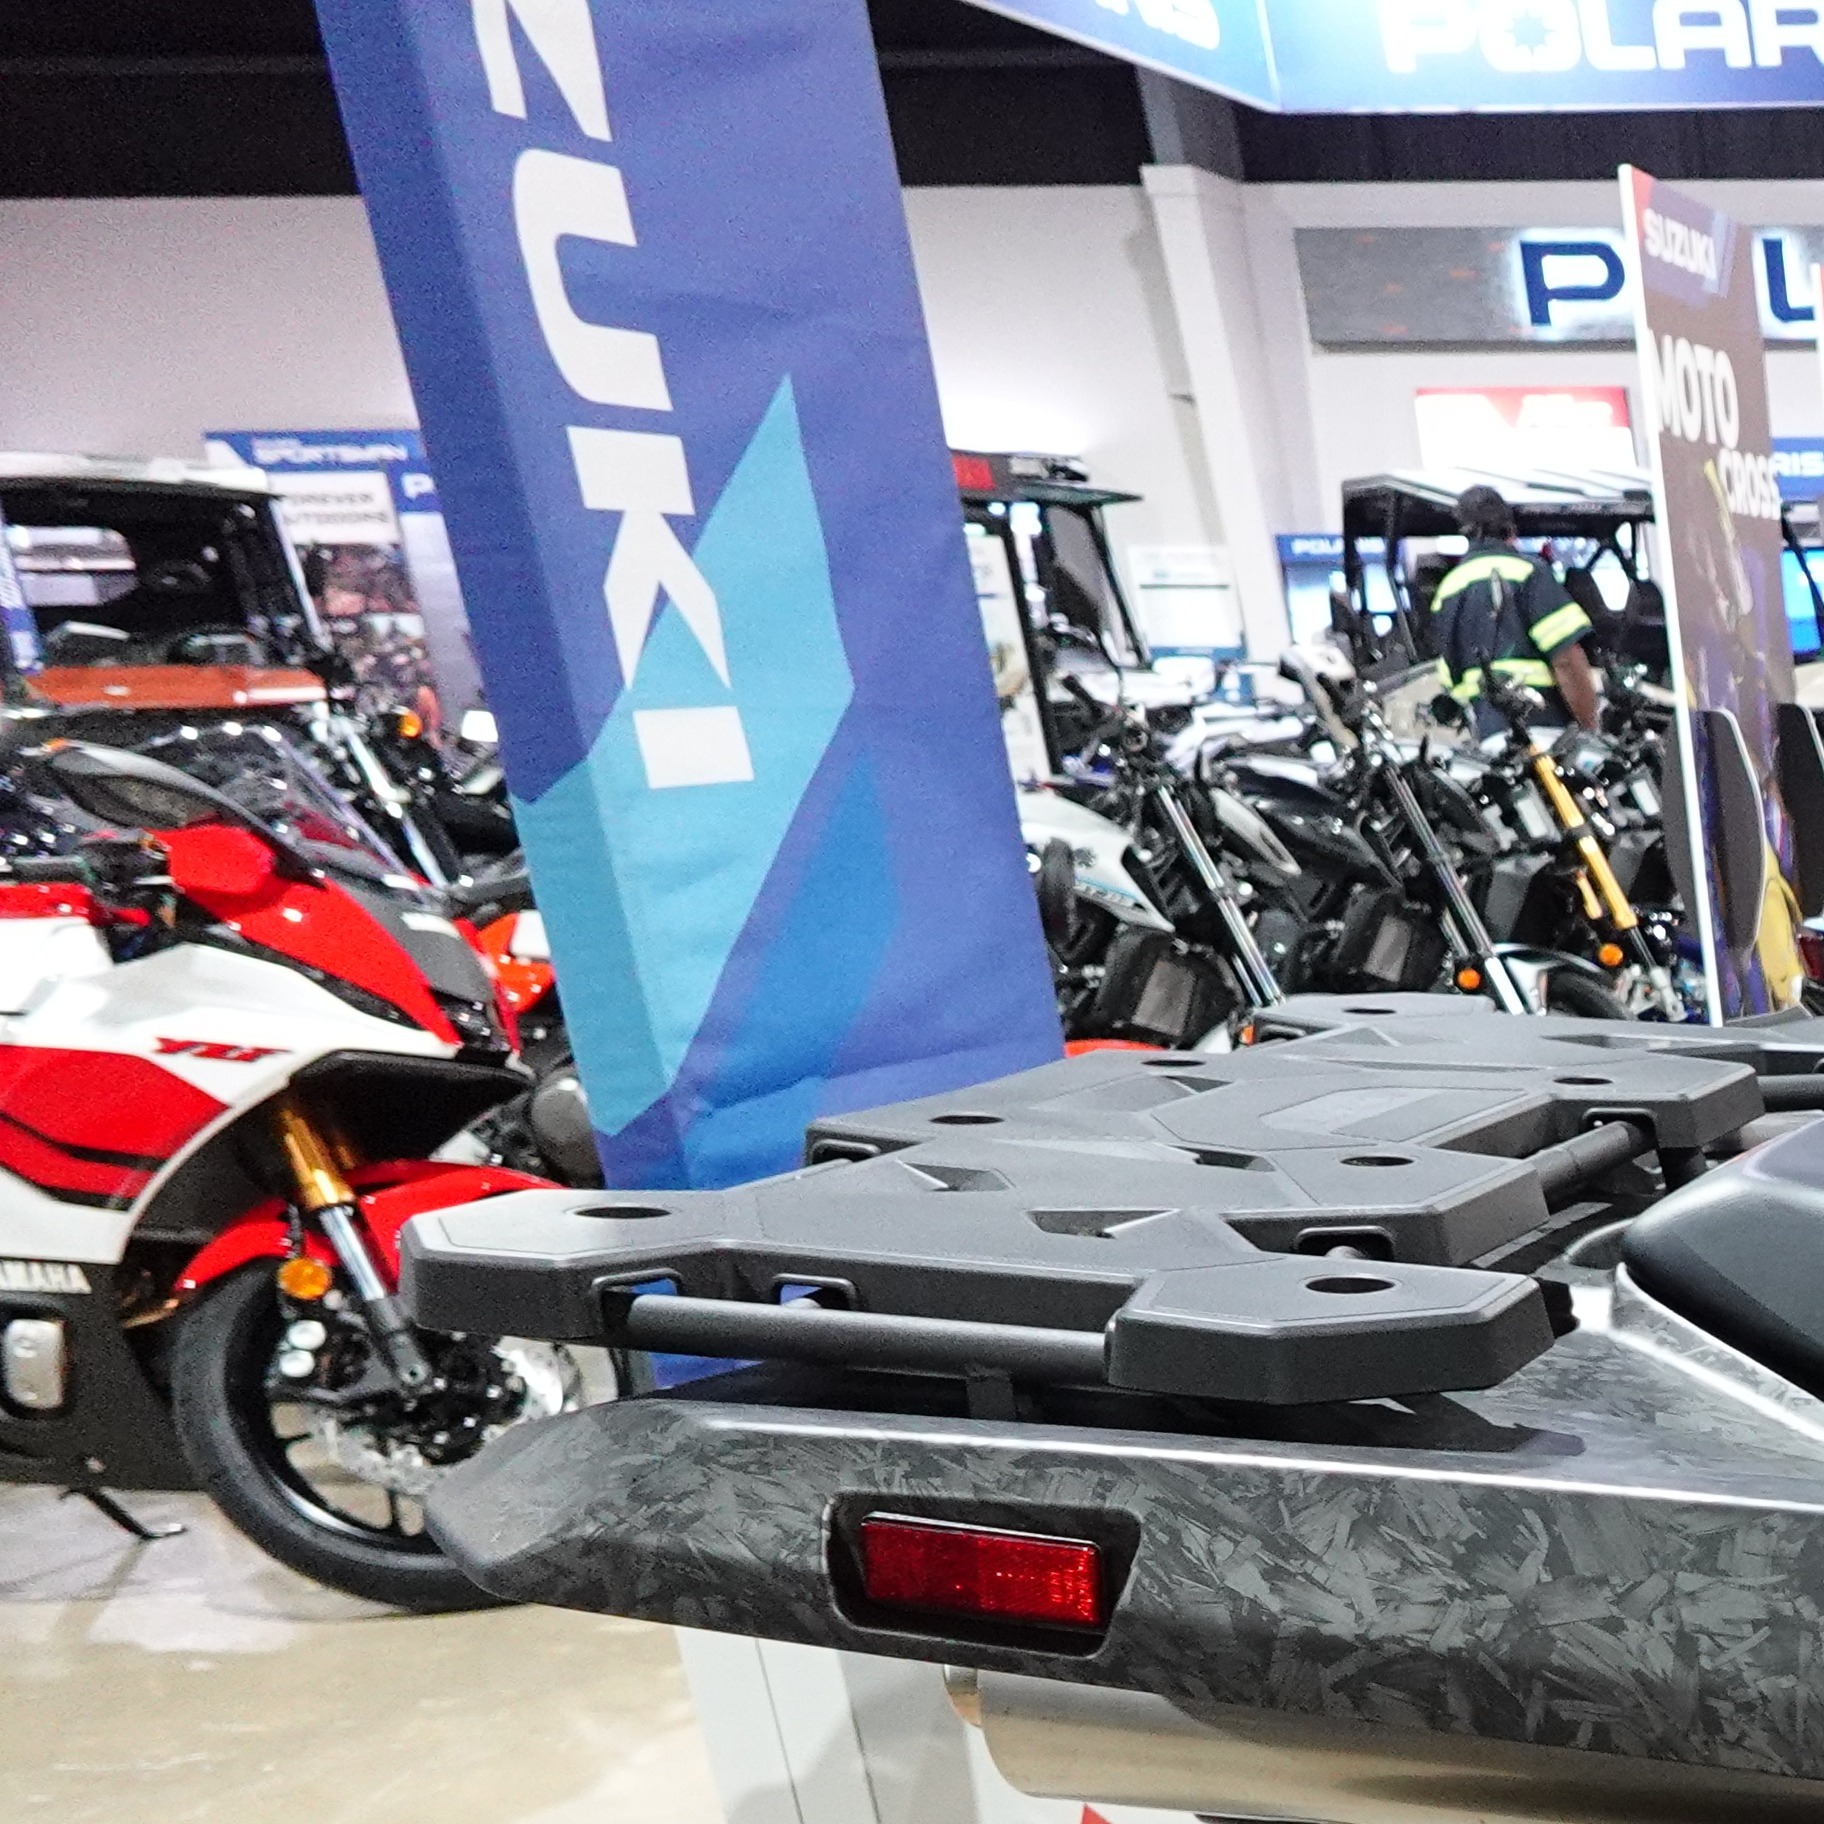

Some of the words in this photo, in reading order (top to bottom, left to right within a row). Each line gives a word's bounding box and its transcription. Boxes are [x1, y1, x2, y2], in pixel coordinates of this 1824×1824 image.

[1643, 208, 1718, 282] SUZUKI
[1648, 328, 1740, 450] MOTO
[1717, 447, 1781, 522] CROSS
